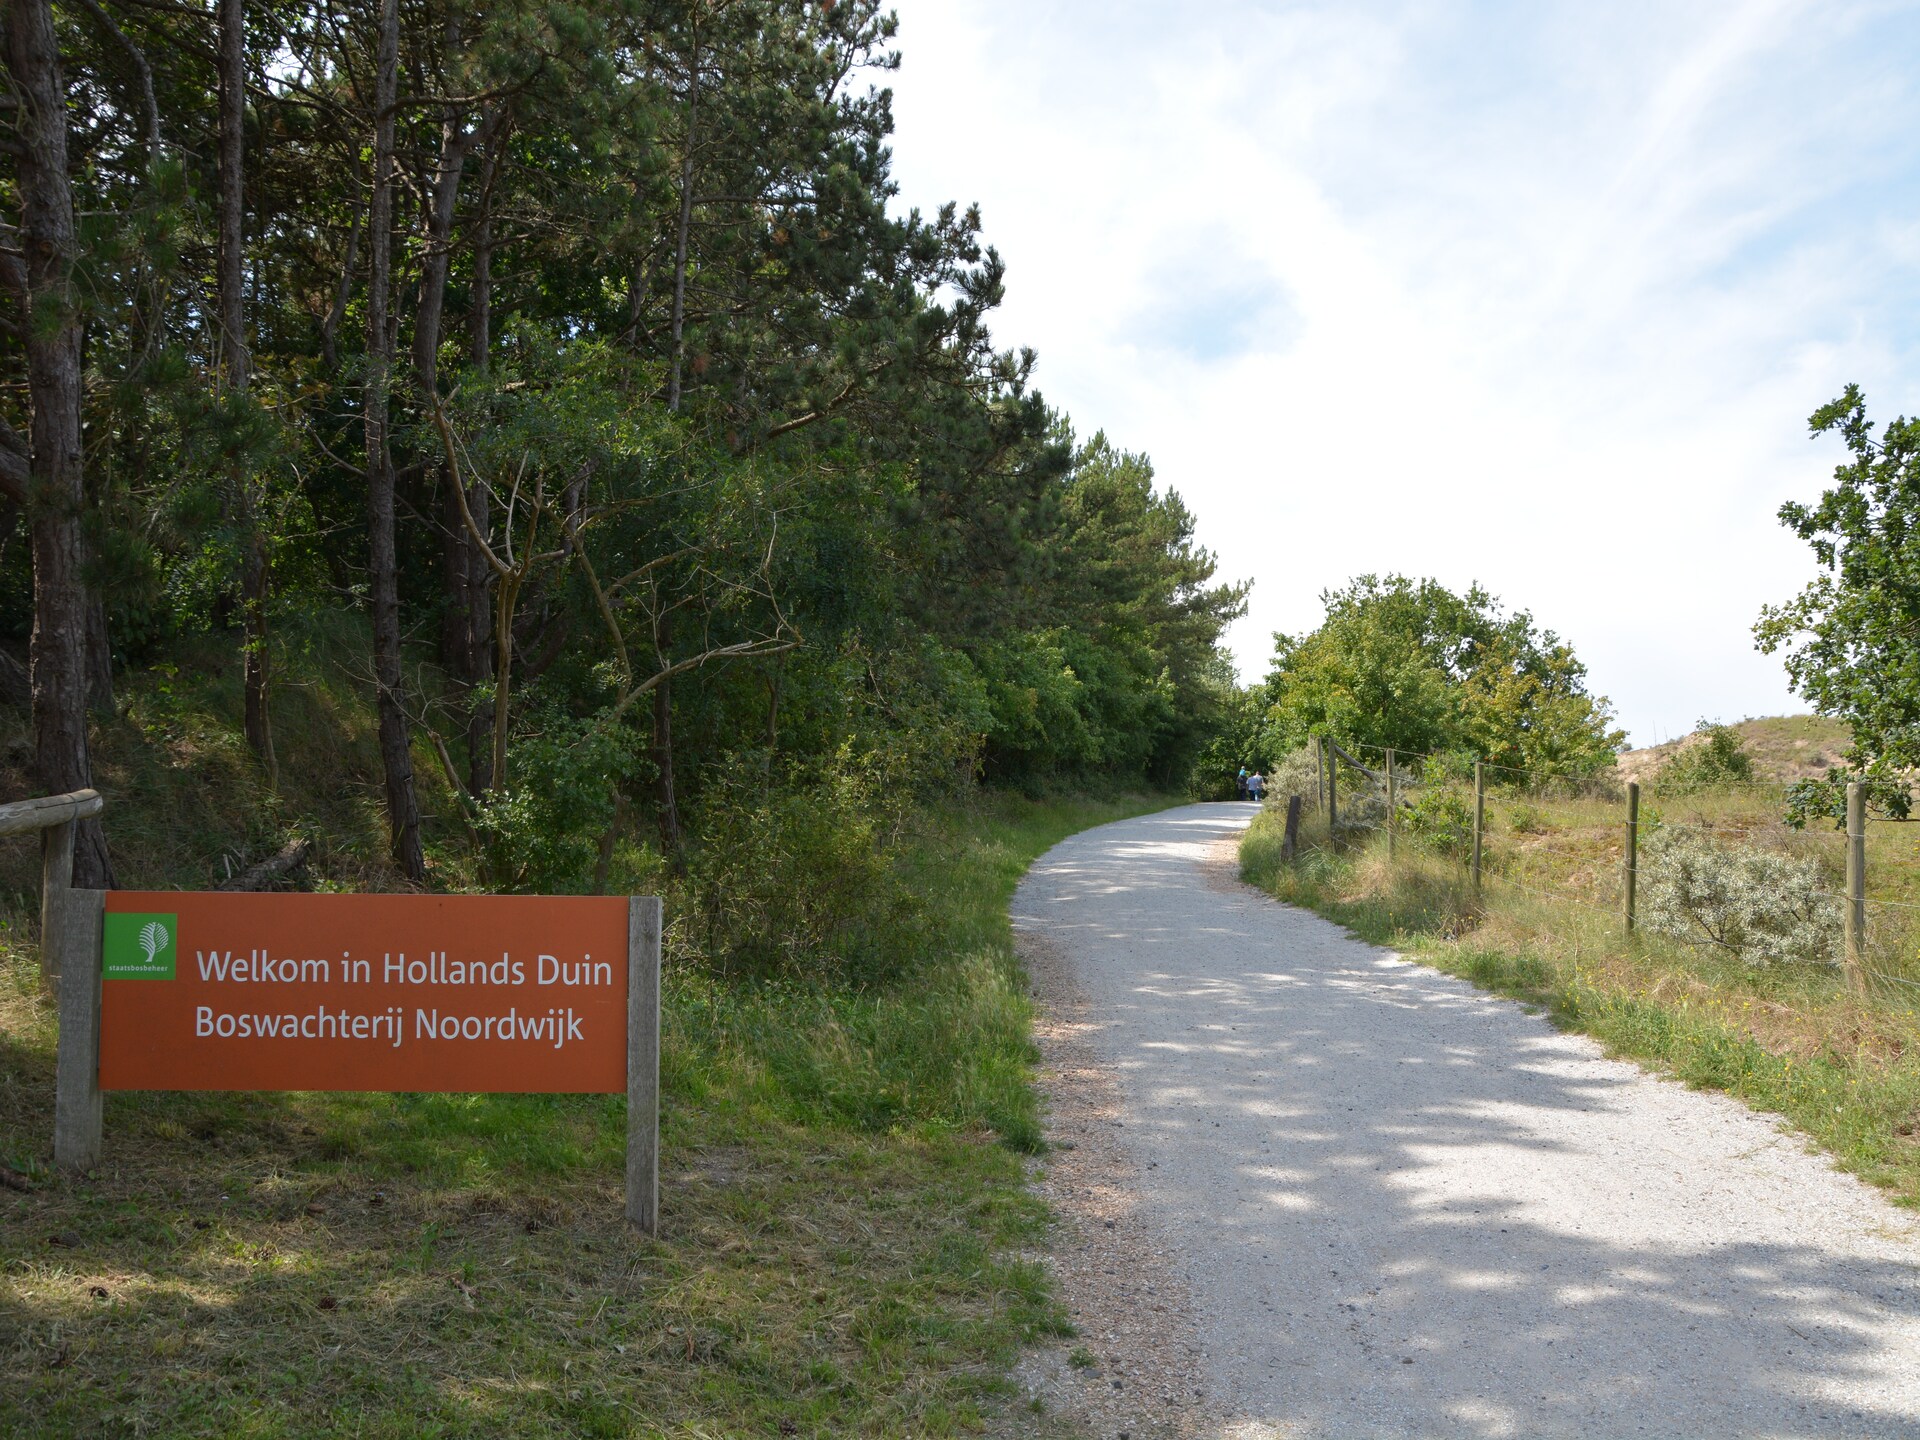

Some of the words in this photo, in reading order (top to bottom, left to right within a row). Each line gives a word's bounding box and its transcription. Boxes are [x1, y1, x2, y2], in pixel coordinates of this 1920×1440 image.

[108, 964, 169, 972] staatsbosbeheer
[196, 949, 329, 983] Welkom
[341, 951, 370, 983] in
[384, 952, 525, 985] Hollands
[537, 953, 612, 986] Duin
[196, 1005, 403, 1048] Boswachterij
[416, 1007, 584, 1049] Noordwijk
